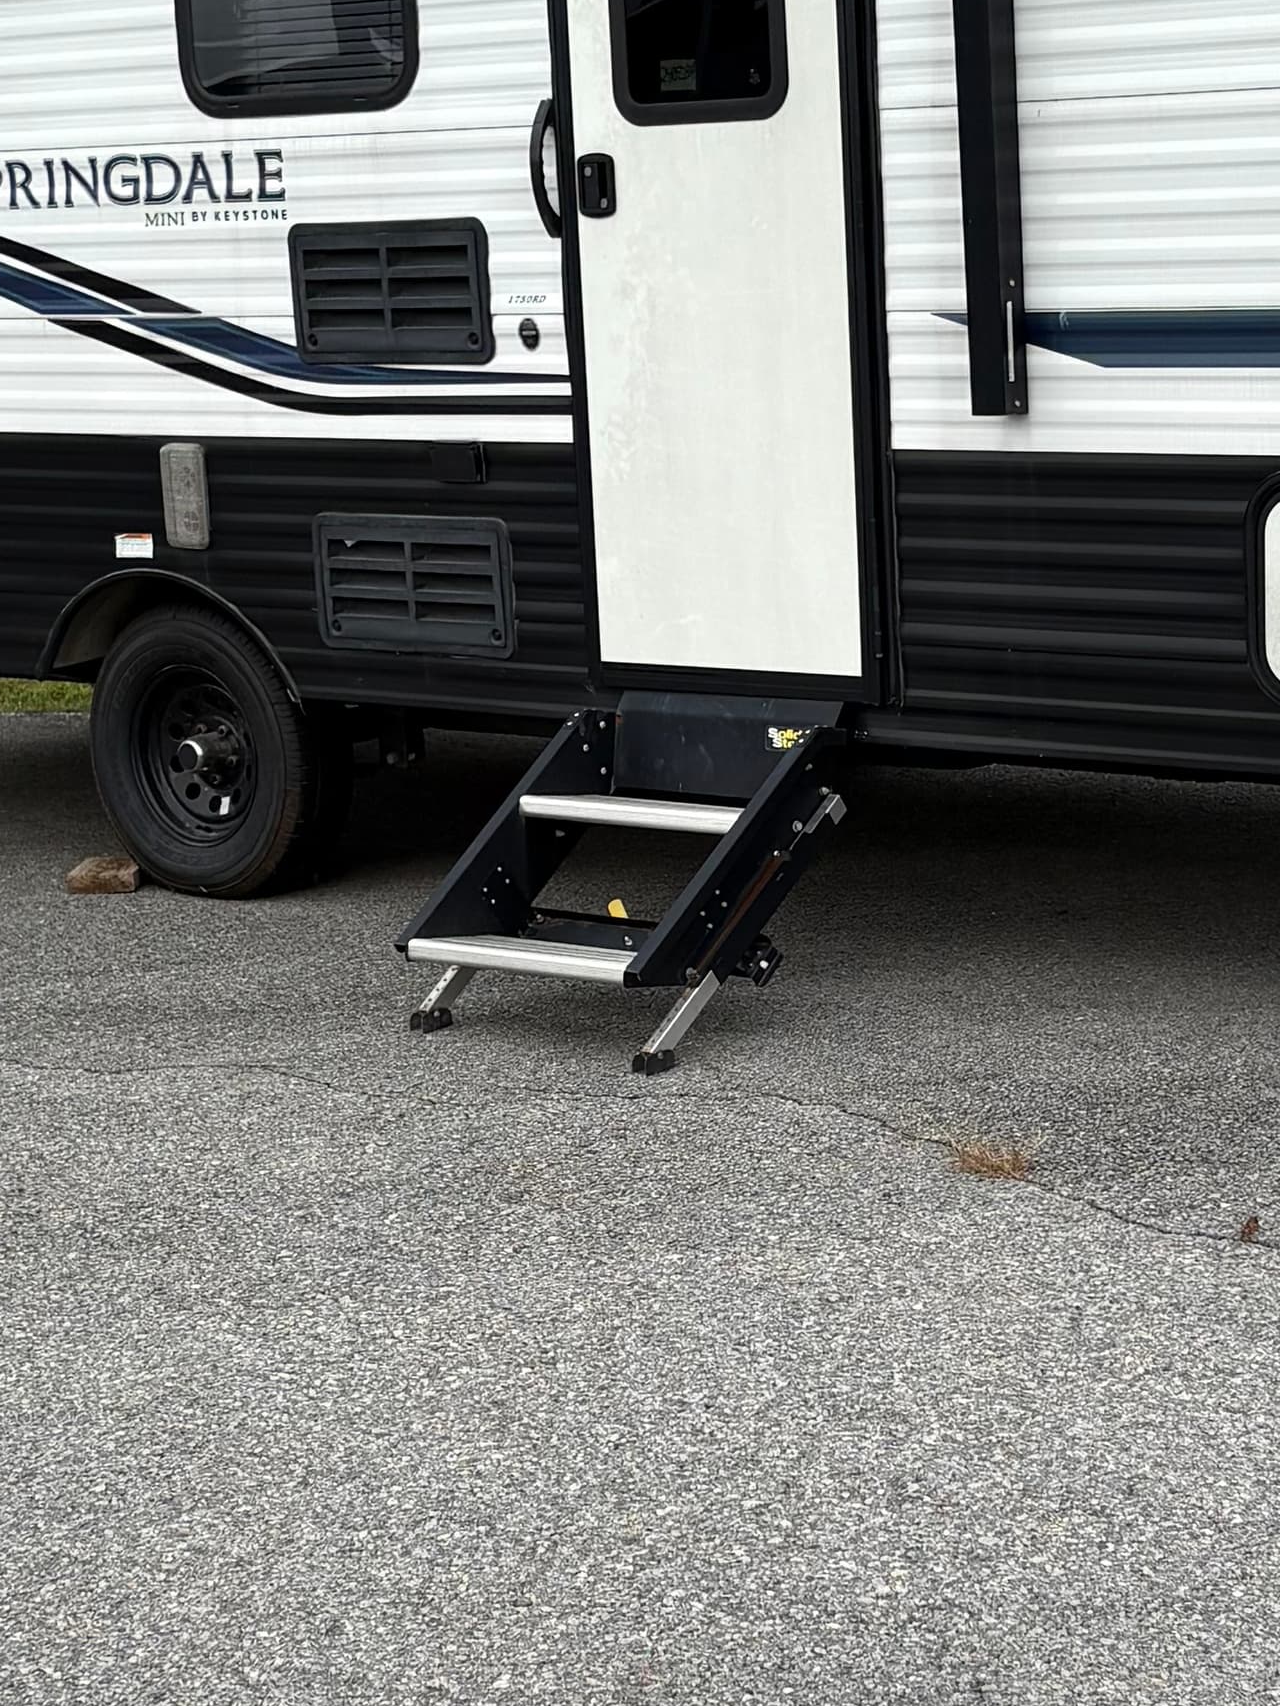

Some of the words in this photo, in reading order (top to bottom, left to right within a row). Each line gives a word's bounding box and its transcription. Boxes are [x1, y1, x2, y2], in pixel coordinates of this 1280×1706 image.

[145, 211, 185, 227] MINI
[191, 210, 207, 222] BY
[214, 209, 288, 221] KEYSTONE
